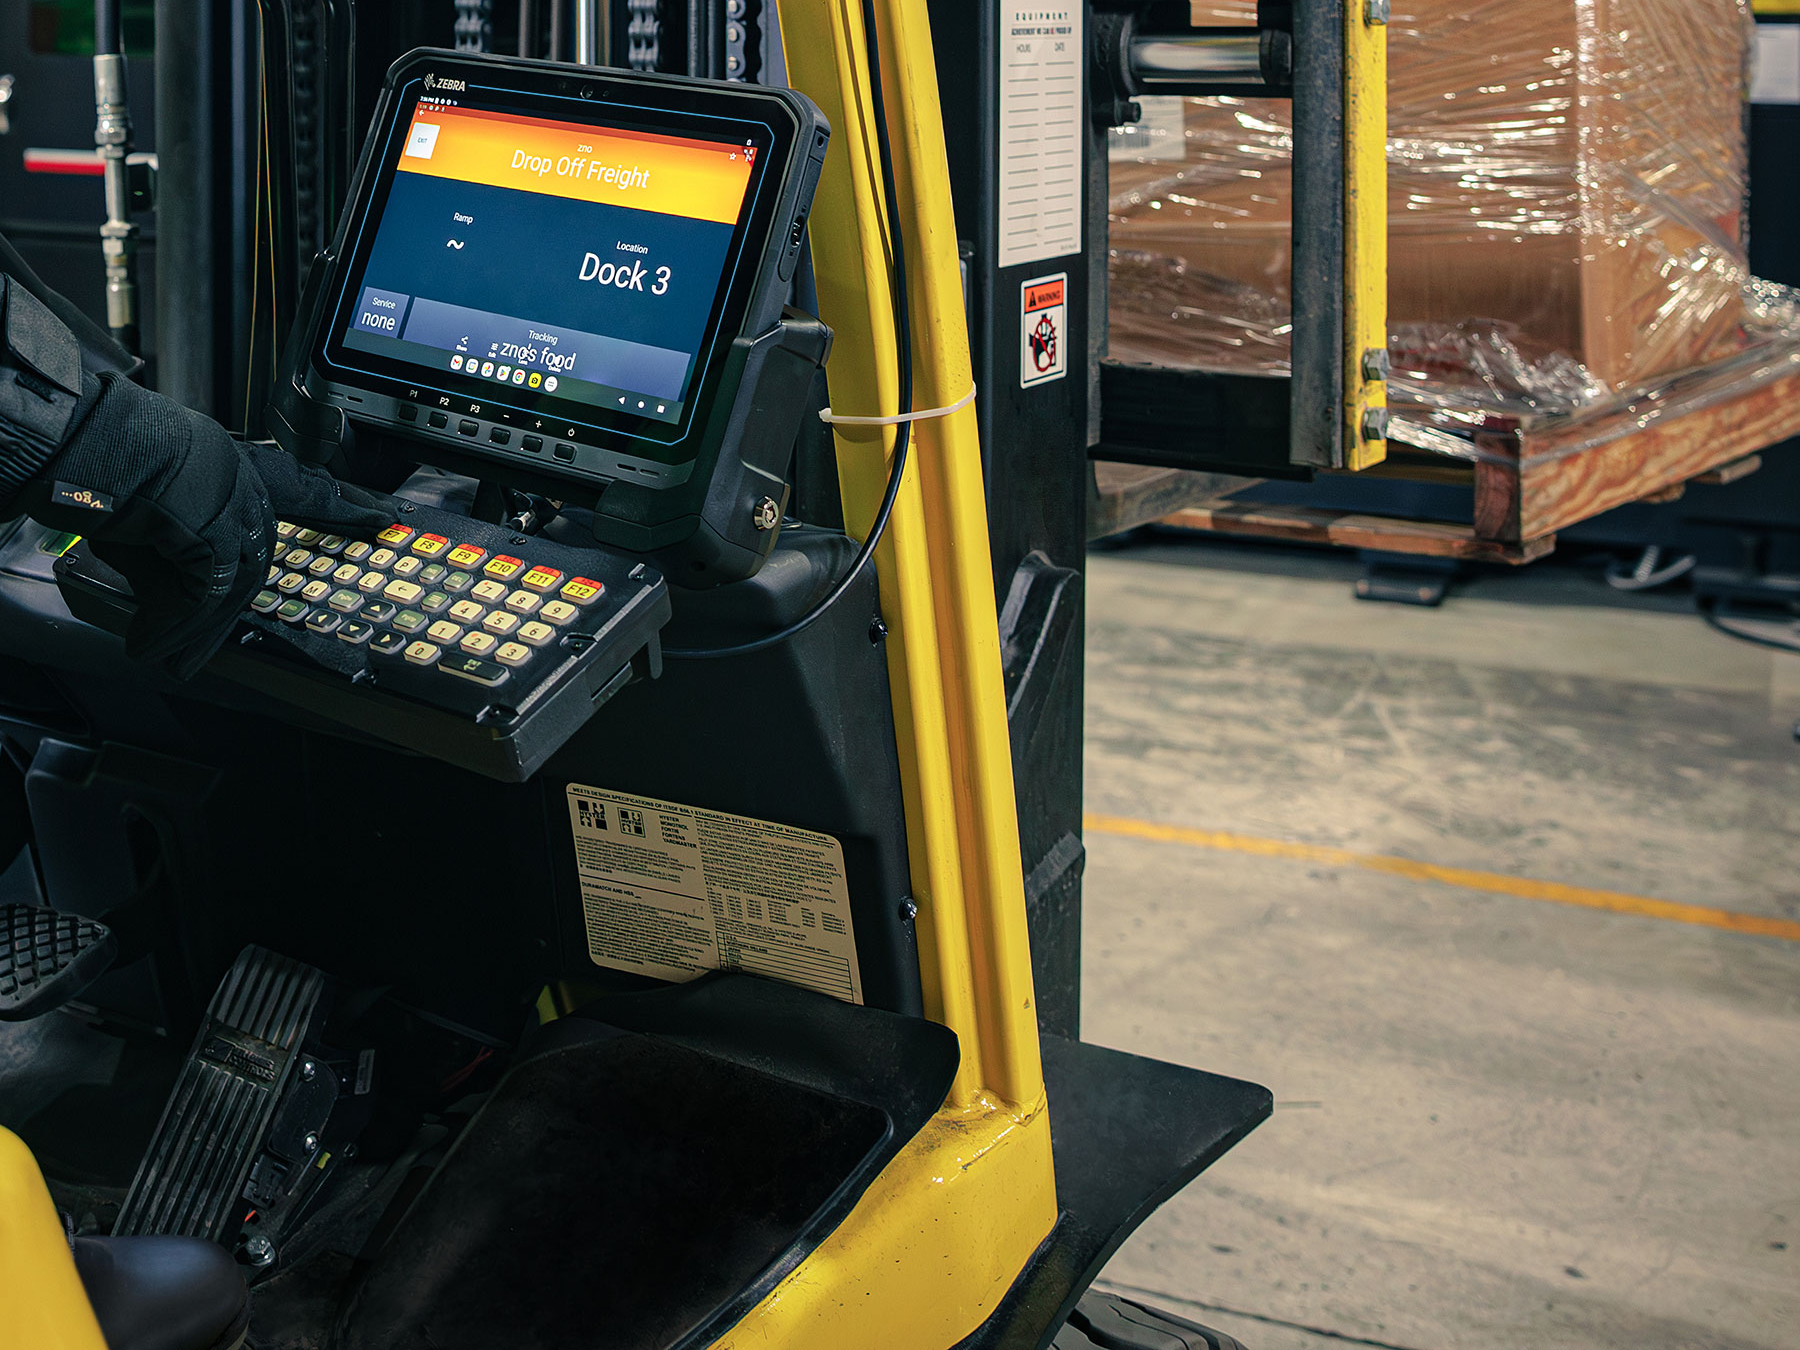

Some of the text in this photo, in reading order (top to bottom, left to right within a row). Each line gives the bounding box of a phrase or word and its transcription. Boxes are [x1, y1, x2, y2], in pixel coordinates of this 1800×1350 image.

[436, 78, 466, 91] ZEBRA
[577, 144, 593, 154] zno
[511, 149, 651, 190] Drop Off Freight
[453, 212, 473, 225] Ramp
[616, 240, 648, 255] Location
[579, 252, 671, 295] Dock 3
[372, 296, 396, 310] Service
[361, 310, 396, 330] none
[528, 330, 559, 346] Tracking
[540, 346, 577, 370] food
[409, 389, 419, 398] P1
[439, 397, 450, 406] P2
[470, 404, 481, 414] P3
[383, 531, 400, 539] F7
[420, 540, 435, 550] F8
[455, 550, 471, 560] F9
[490, 562, 511, 573] F10
[283, 578, 293, 586] N
[528, 573, 550, 584] F11
[306, 586, 318, 594] M
[482, 586, 493, 594] 7
[566, 584, 590, 596] F12
[516, 596, 526, 605] 8
[551, 607, 561, 615] 9
[494, 617, 504, 625] 5
[529, 628, 539, 636] 6
[471, 638, 481, 646] 2
[506, 648, 517, 657] 3
[591, 789, 611, 798] DESIGN
[611, 793, 654, 807] SPECIFICATIONS
[694, 810, 724, 821] STANDARD
[732, 818, 753, 826] EFFECT
[580, 810, 605, 819] HYSTER
[660, 820, 689, 830] MONOTROL
[663, 837, 697, 849] YARDMASTER
